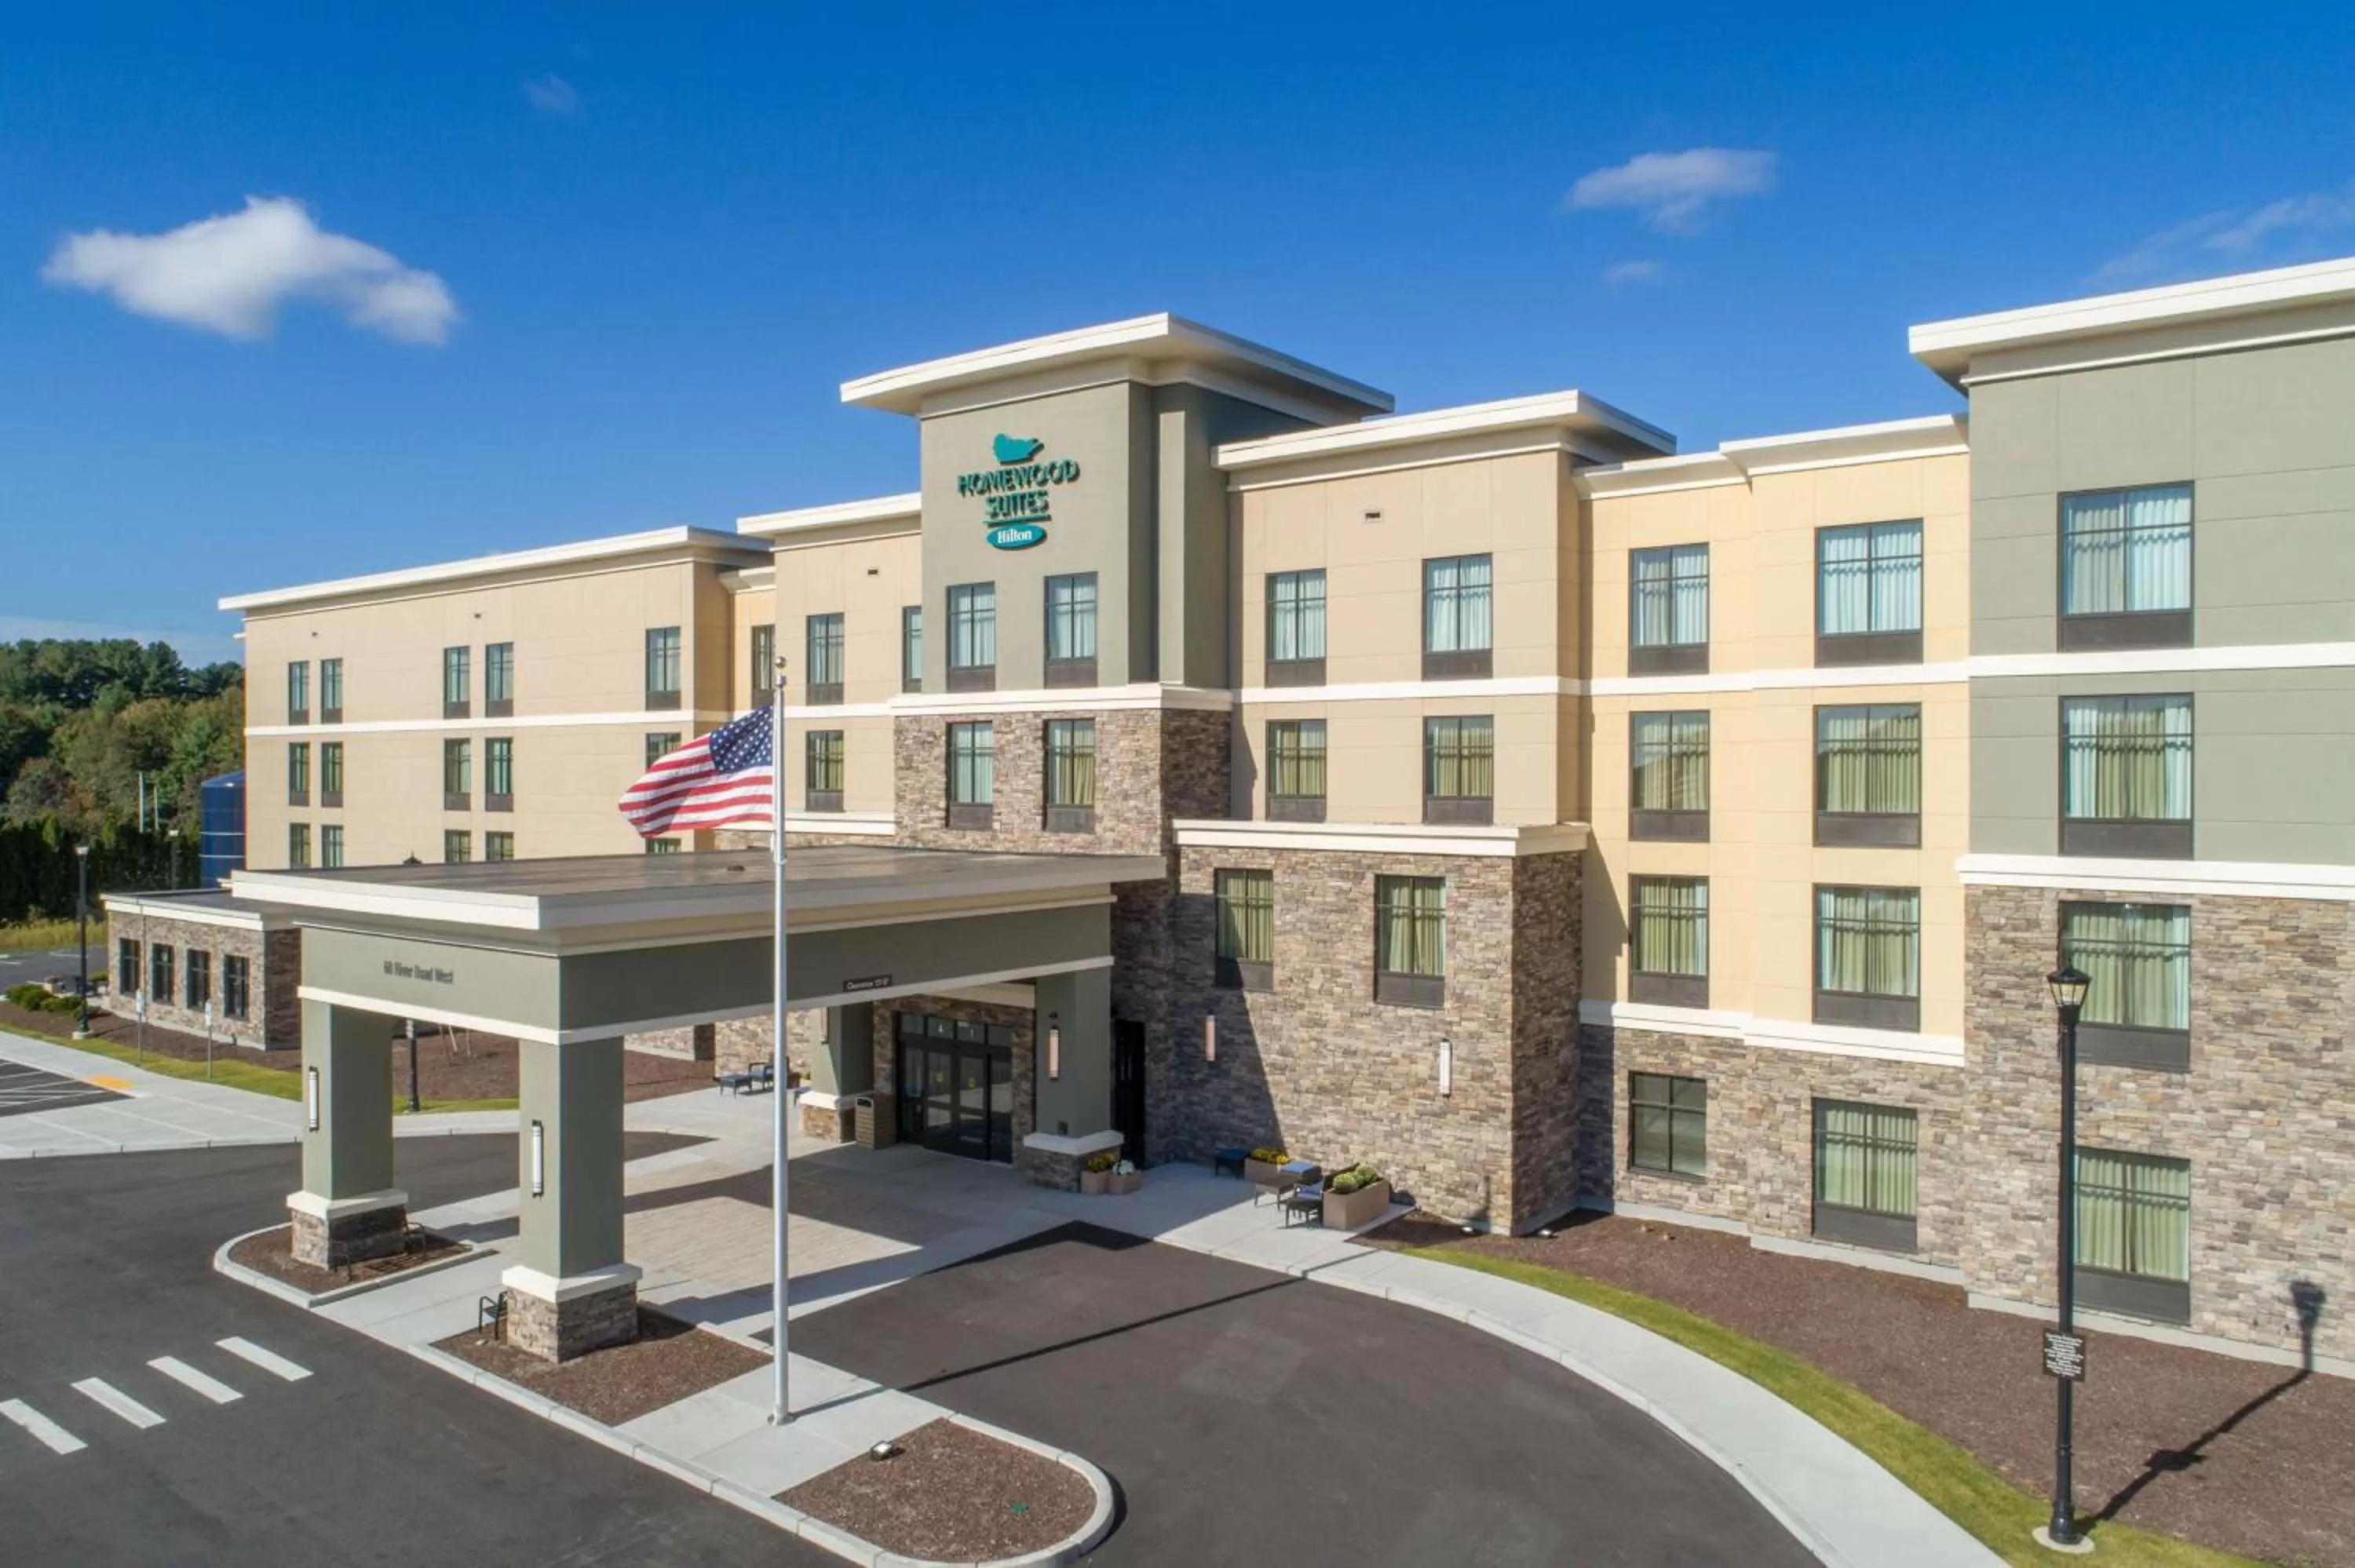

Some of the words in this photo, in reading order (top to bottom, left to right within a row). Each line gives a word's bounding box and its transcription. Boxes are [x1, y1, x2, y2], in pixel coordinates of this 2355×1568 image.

[957, 460, 1080, 498] HOMEWOOD
[984, 489, 1050, 520] SUITES
[997, 528, 1032, 543] Hilton
